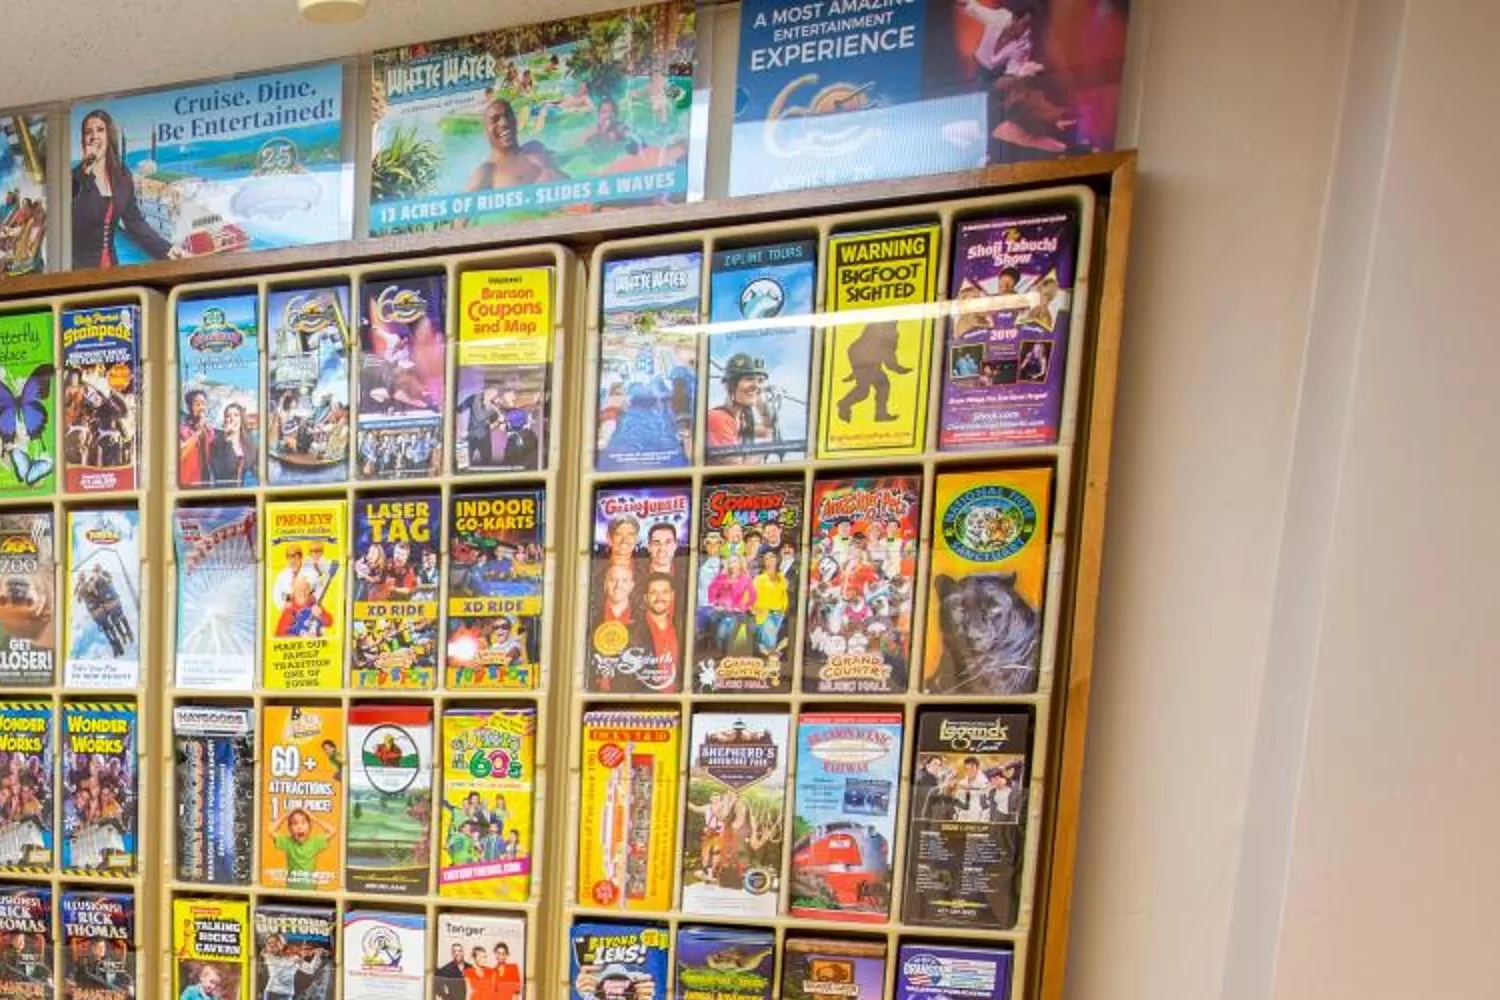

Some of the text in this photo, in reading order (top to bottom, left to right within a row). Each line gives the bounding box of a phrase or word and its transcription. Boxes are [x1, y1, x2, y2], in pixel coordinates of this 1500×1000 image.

[753, 13, 767, 28] A
[772, 3, 823, 25] MOST
[773, 12, 894, 43] ENTERTAINMENT
[751, 26, 916, 71] EXPERIENCE
[387, 55, 497, 94] WHITE WATER
[174, 80, 317, 116] Cruise. Dine.
[158, 98, 333, 142] Be Entertained!
[401, 201, 446, 221] ACRES
[452, 196, 473, 213] OF
[535, 182, 591, 204] SLIDES
[616, 169, 675, 194] WAVES
[840, 237, 926, 263] WARNING
[967, 237, 1058, 259] Shoji Tabuchi
[993, 252, 1032, 267] Show
[840, 265, 920, 285] BIGFOOT
[481, 287, 533, 300] Branson
[845, 283, 915, 301] SIGHTED
[467, 300, 543, 321] Coupons
[473, 319, 537, 337] and Map
[366, 501, 429, 520] LASER
[456, 499, 535, 518] INDOOR
[370, 519, 432, 543] TAG
[455, 514, 535, 532] GO-KARTS
[0, 556, 37, 573] ZOO
[366, 604, 426, 617] XD RIDE
[463, 600, 523, 613] XD RIDE
[8, 639, 31, 652] GET
[831, 655, 880, 667] GRAND
[67, 714, 127, 734] WONDER
[939, 718, 1009, 750] Legends
[71, 734, 124, 754] WORKS
[701, 746, 775, 759] SHEPHERD'S
[78, 911, 113, 925] RICK
[195, 921, 241, 933] TALKING
[65, 922, 128, 940] THOMAS
[198, 932, 237, 944] ROCKS
[445, 922, 485, 936] Tanger
[589, 935, 638, 951] BEYOND
